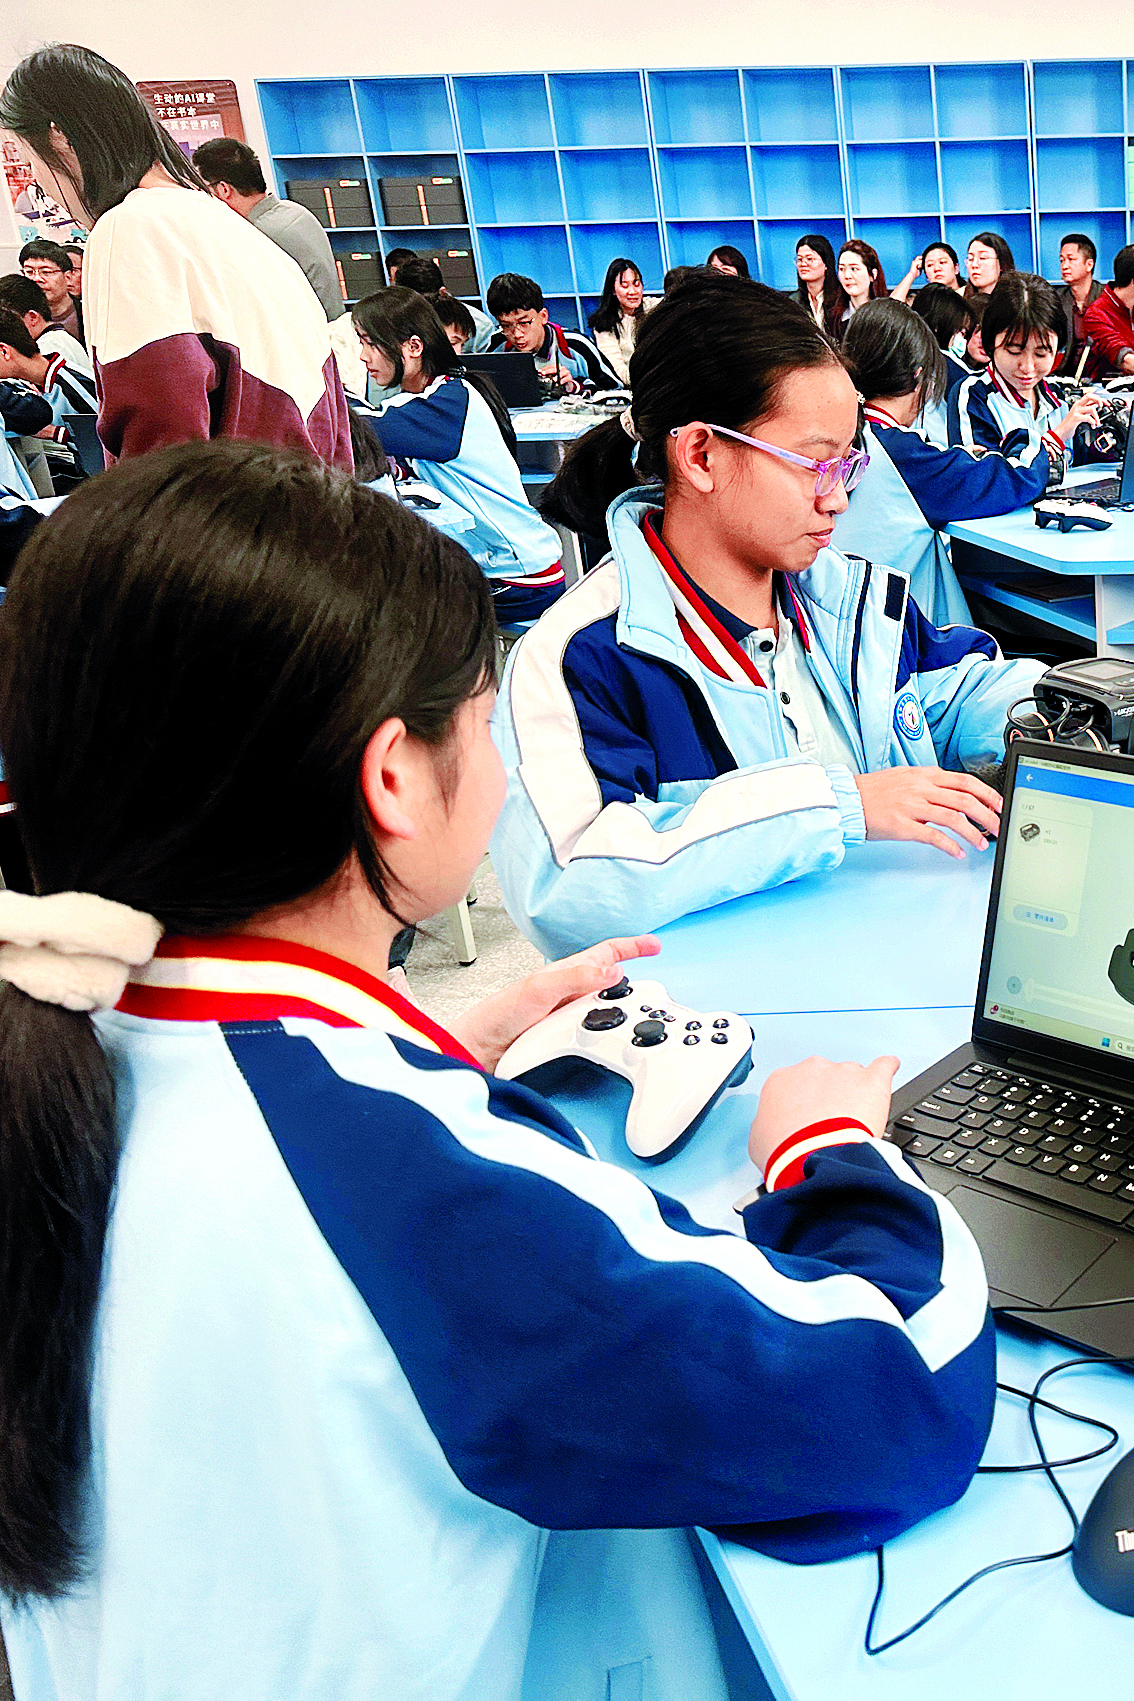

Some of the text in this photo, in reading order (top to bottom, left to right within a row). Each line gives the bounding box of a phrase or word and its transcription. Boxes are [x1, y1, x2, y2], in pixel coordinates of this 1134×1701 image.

[153, 93, 216, 105] 生动的AI课堂
[156, 106, 197, 118] 不在书本
